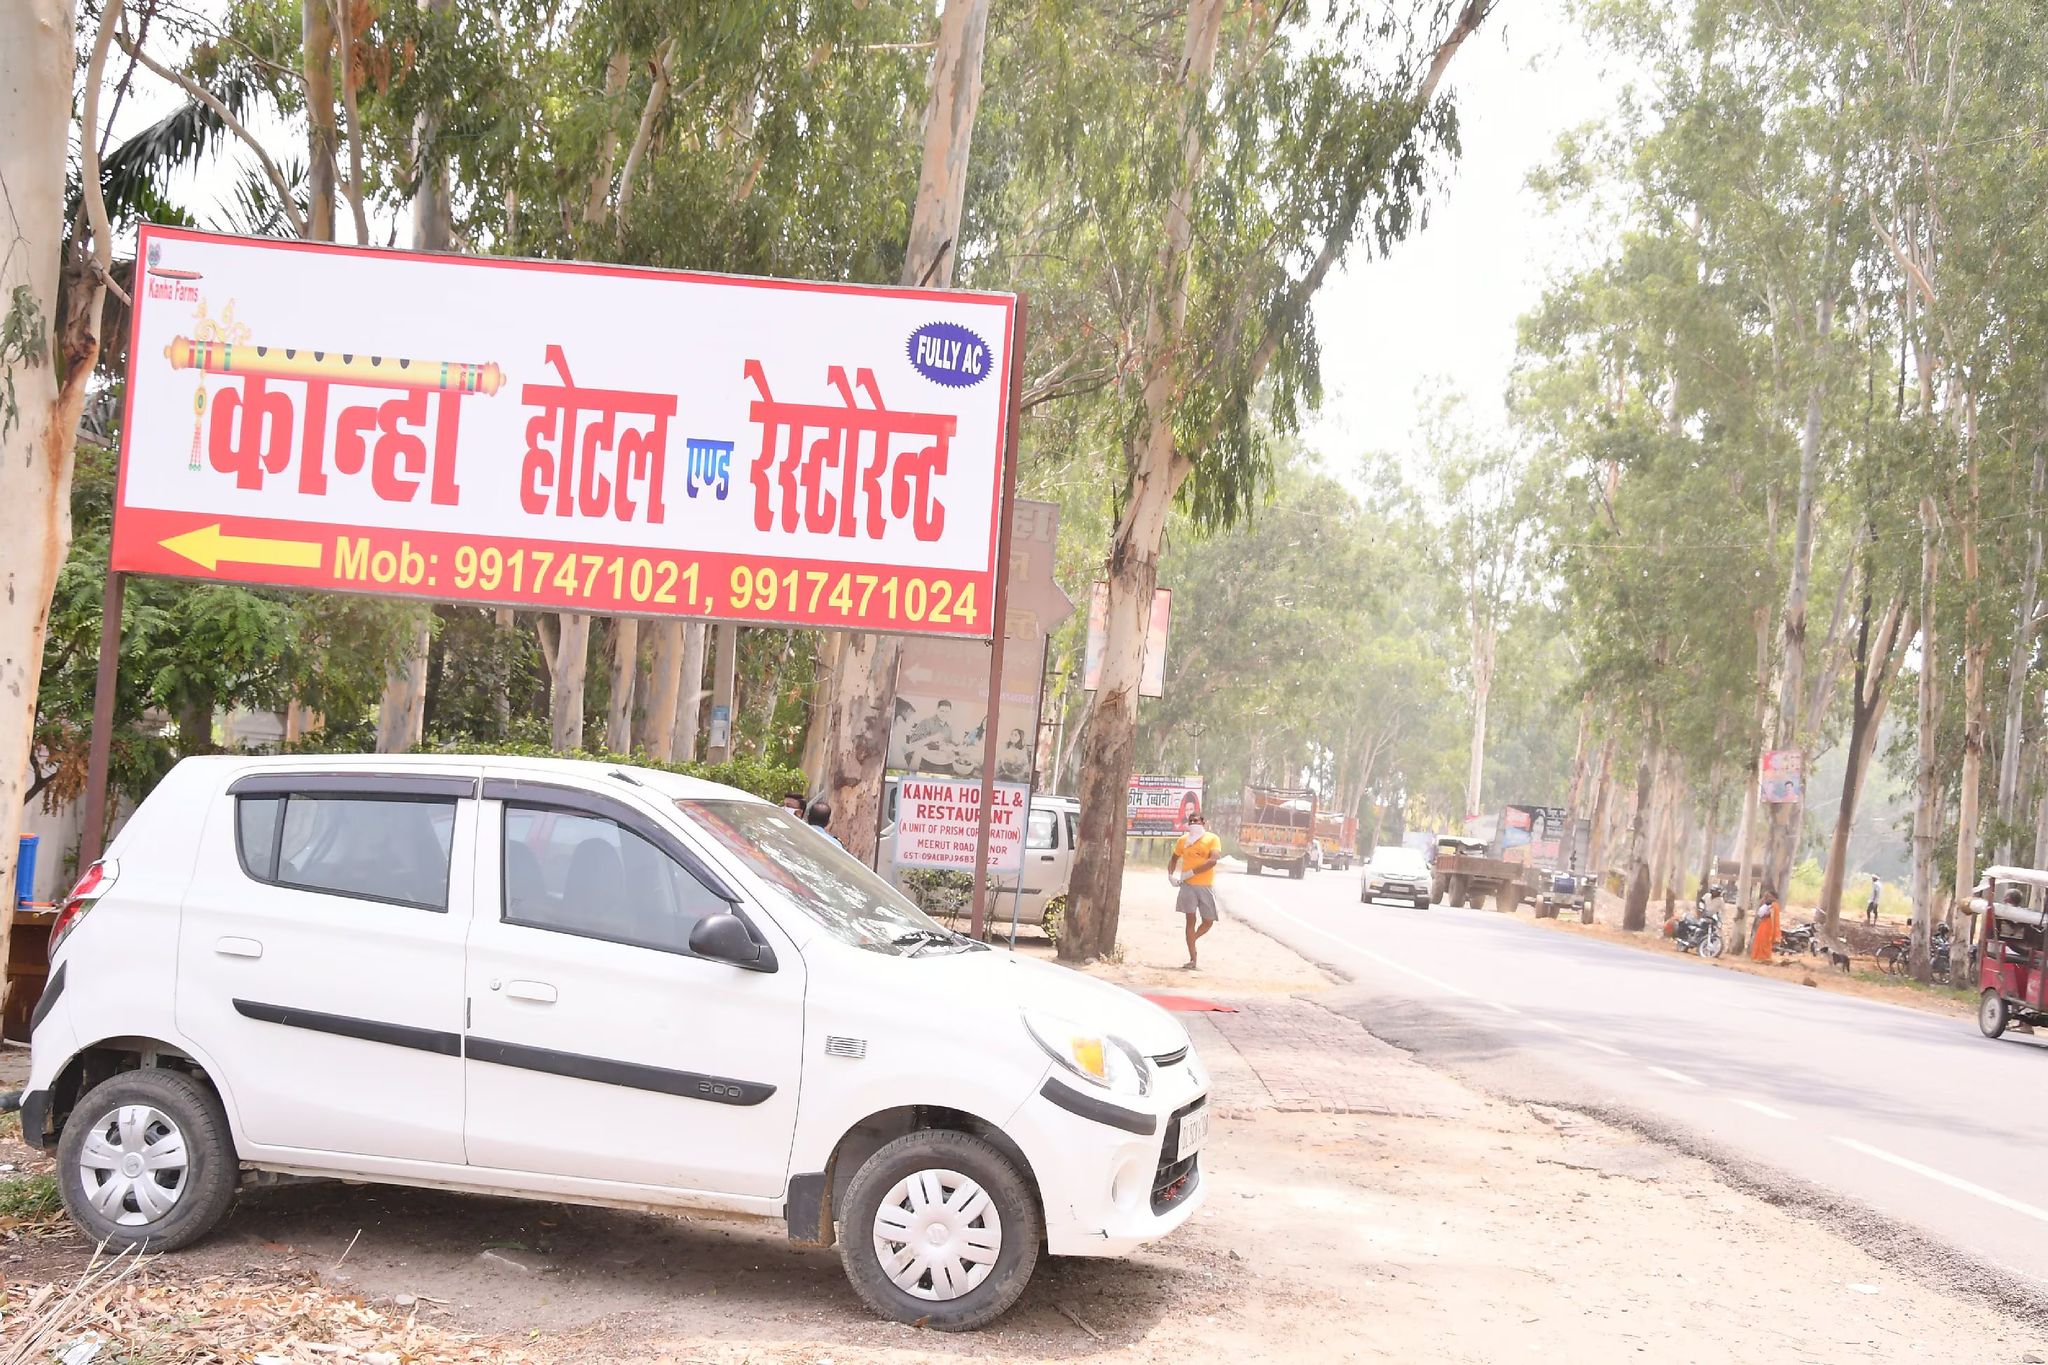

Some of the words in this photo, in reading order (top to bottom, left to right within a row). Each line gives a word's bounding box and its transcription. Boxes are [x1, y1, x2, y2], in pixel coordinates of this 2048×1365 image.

[148, 277, 173, 300] Kanha
[175, 280, 199, 303] Farms
[916, 334, 962, 371] FULLY
[961, 343, 984, 375] AC
[203, 369, 475, 507] कान्हा
[519, 343, 679, 525] होटल
[743, 358, 958, 542] रेस्टोरेन्ट
[332, 535, 438, 586] Mob:
[453, 545, 715, 615] 9917471021,
[729, 565, 978, 625] 9917471024
[903, 783, 953, 803] KANHA
[959, 787, 1010, 806] HOEL
[1012, 791, 1023, 808] &
[916, 804, 1013, 825] RESTAURNT
[909, 823, 926, 834] UNIT
[928, 824, 938, 835] OF
[940, 825, 965, 837] PRISM
[917, 839, 951, 851] MEERUT
[953, 841, 975, 852] ROAD
[698, 1080, 742, 1098] 800
